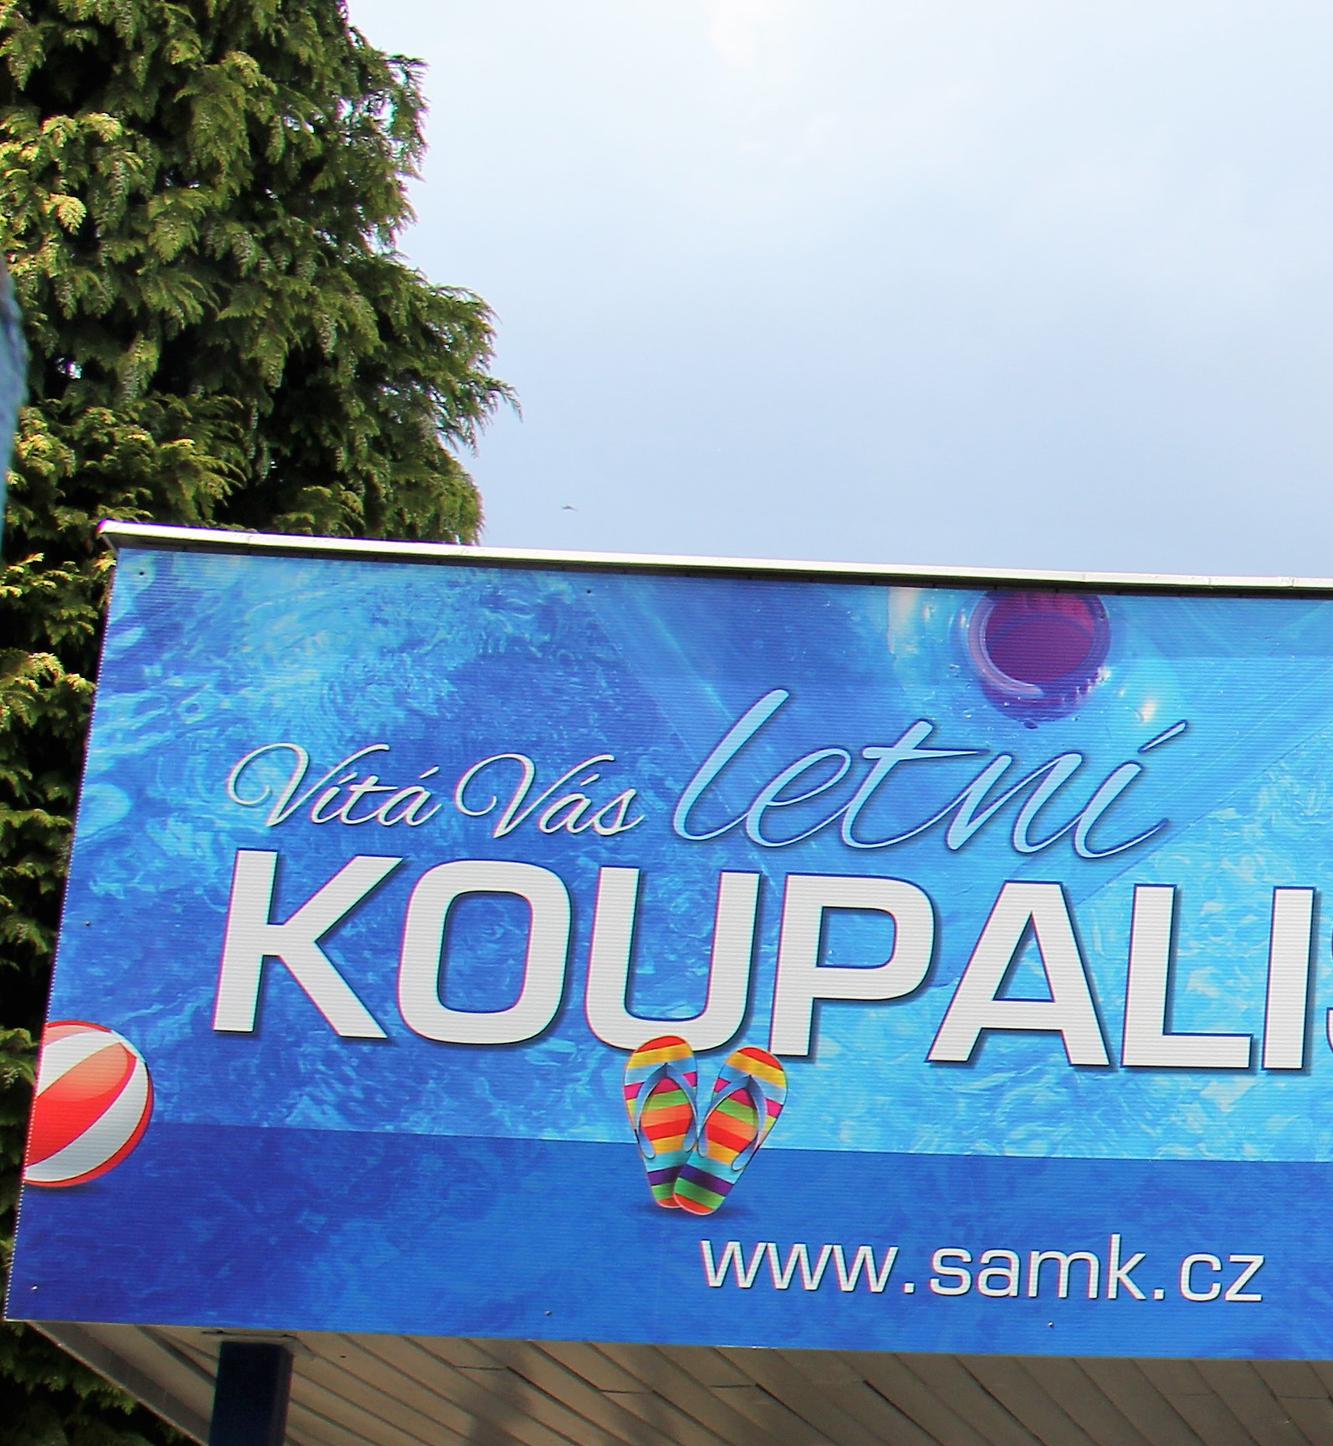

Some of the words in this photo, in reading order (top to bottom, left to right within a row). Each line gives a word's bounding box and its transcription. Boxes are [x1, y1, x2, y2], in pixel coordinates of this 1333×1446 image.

[225, 742, 442, 830] Vítá
[453, 754, 644, 839] Vás
[672, 688, 1188, 859] letní
[700, 1233, 1264, 1302] www.samk.cz
